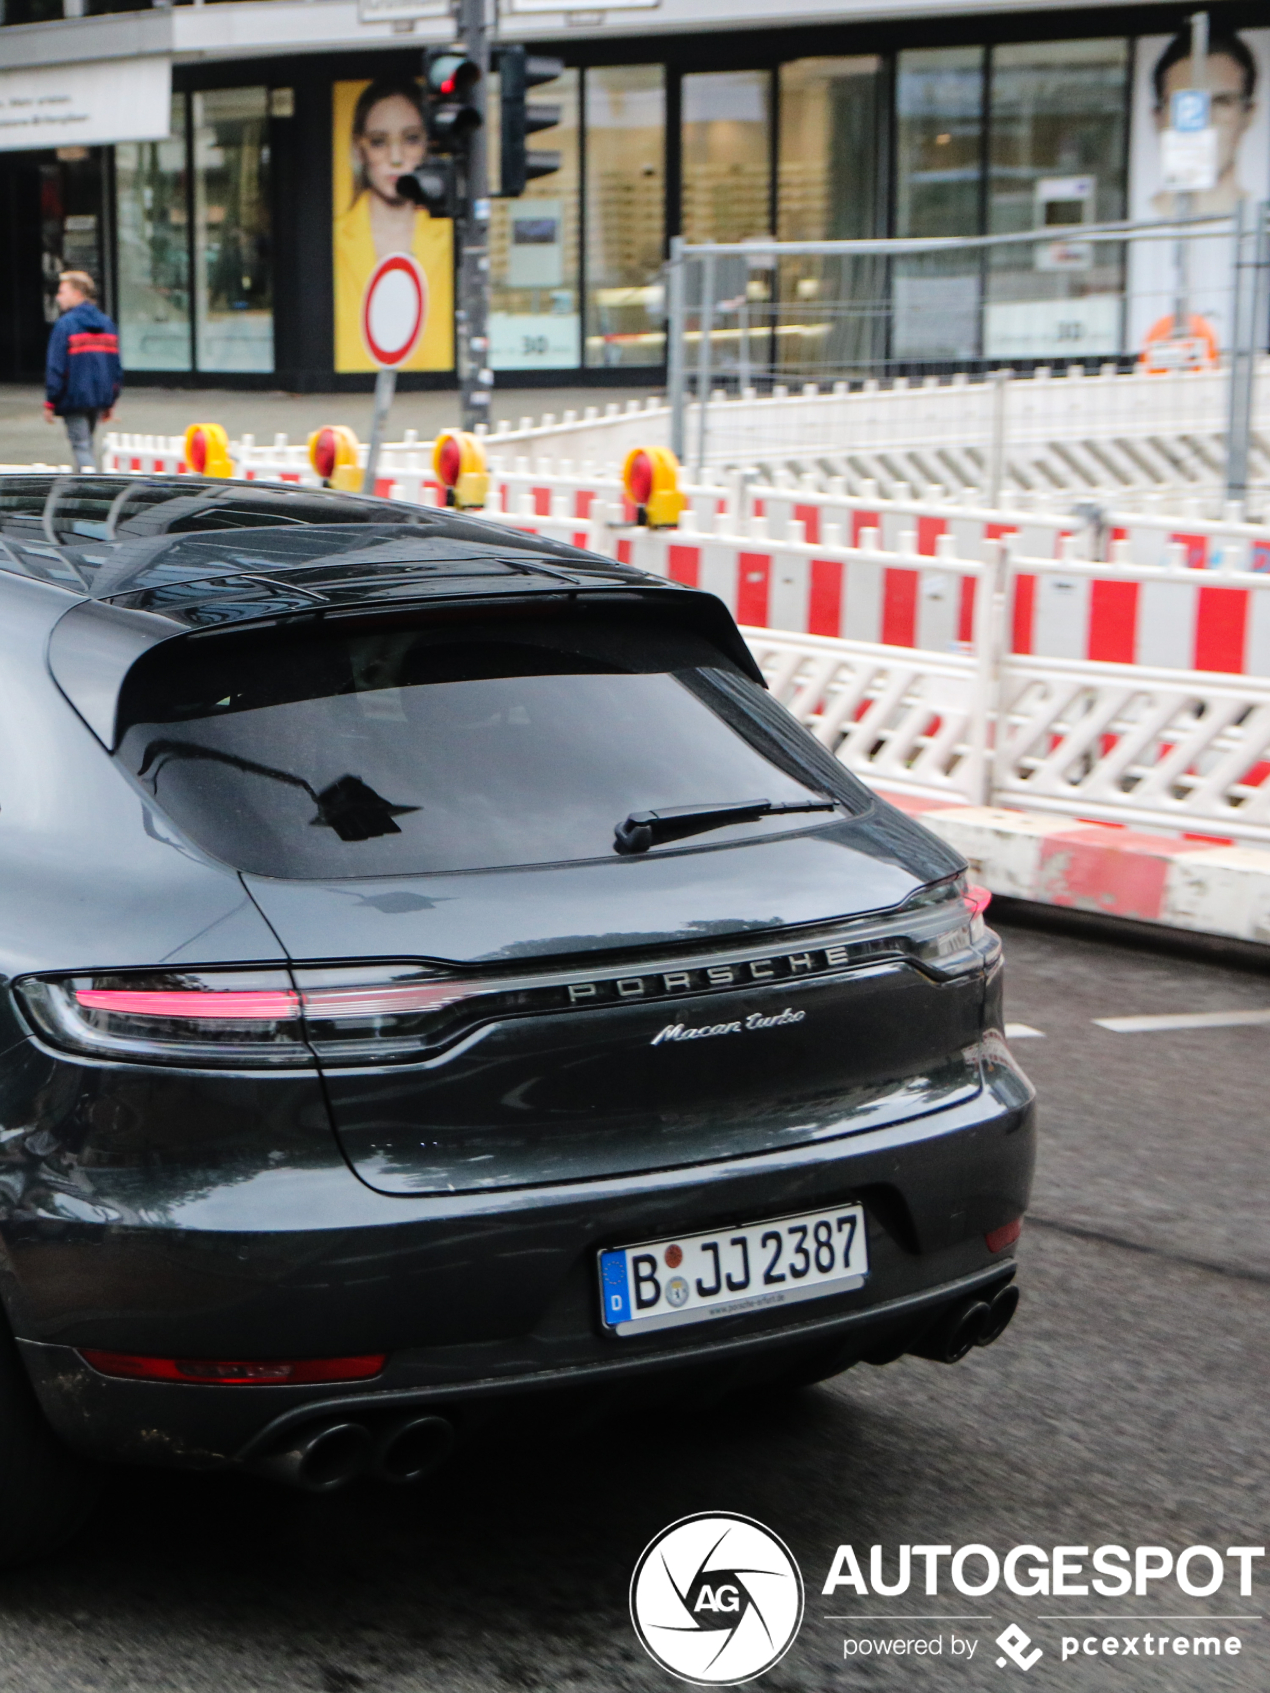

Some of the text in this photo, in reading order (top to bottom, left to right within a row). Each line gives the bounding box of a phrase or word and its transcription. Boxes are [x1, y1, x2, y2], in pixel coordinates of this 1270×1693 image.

[568, 946, 849, 1002] PORSCHE
[650, 1007, 806, 1046] Macan turbo
[632, 1213, 858, 1310] B JJ 2387
[611, 1294, 623, 1311] D
